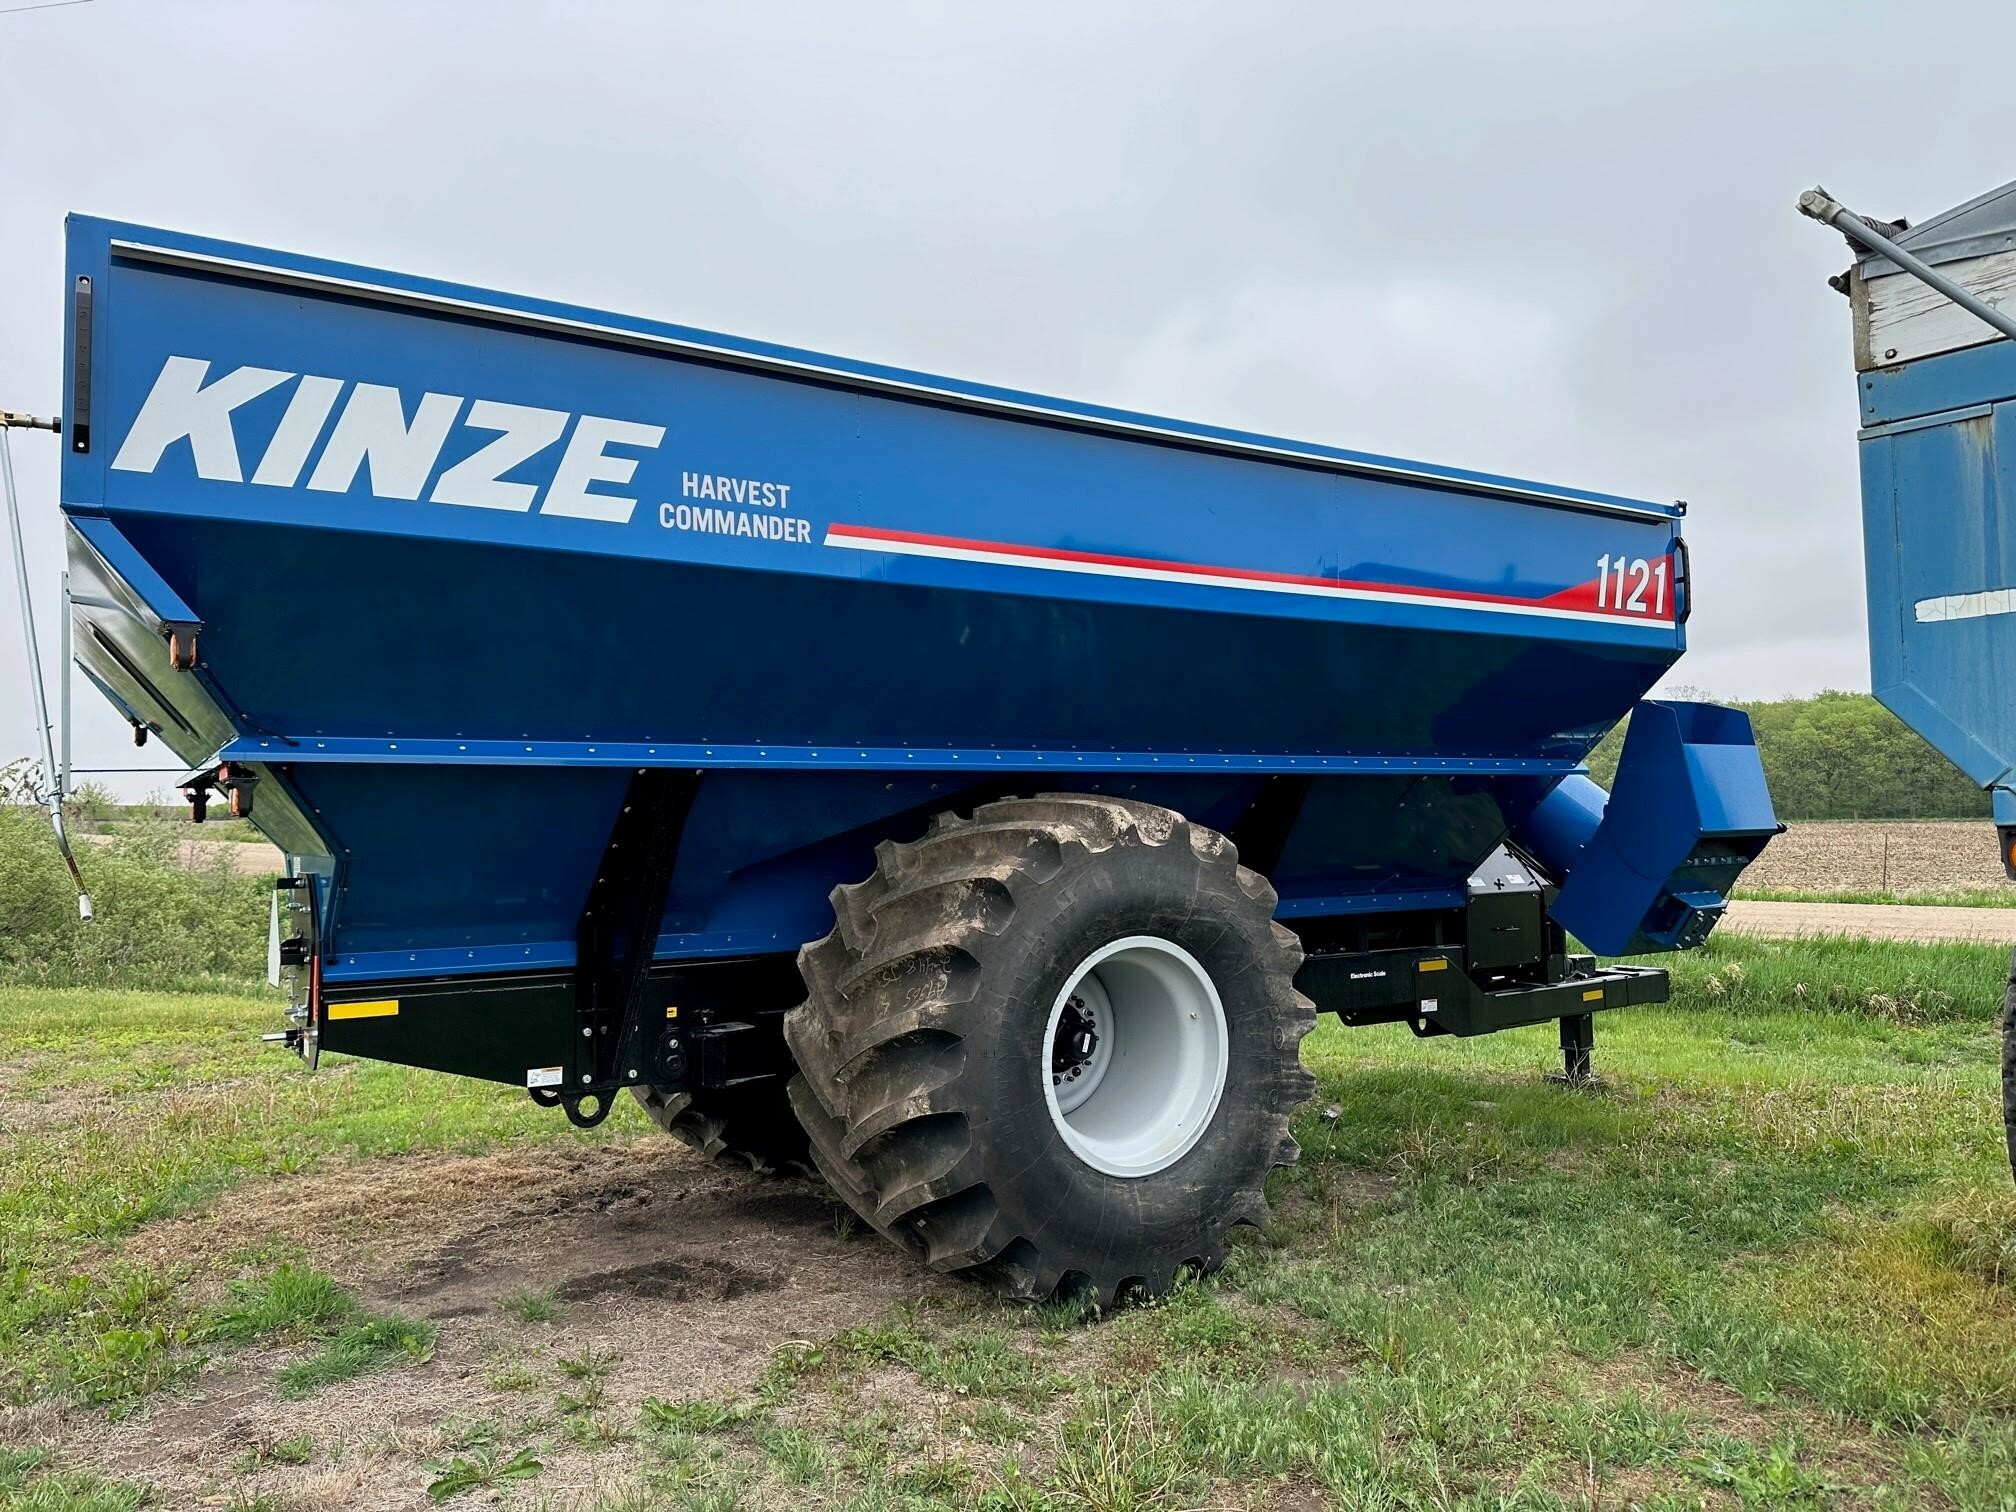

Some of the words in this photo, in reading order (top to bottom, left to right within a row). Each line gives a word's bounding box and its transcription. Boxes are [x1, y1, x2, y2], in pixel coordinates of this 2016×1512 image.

[110, 355, 667, 523] KINZE
[682, 471, 791, 509] HARVEST
[659, 503, 812, 544] COMMANDER
[1597, 553, 1666, 614] 1121
